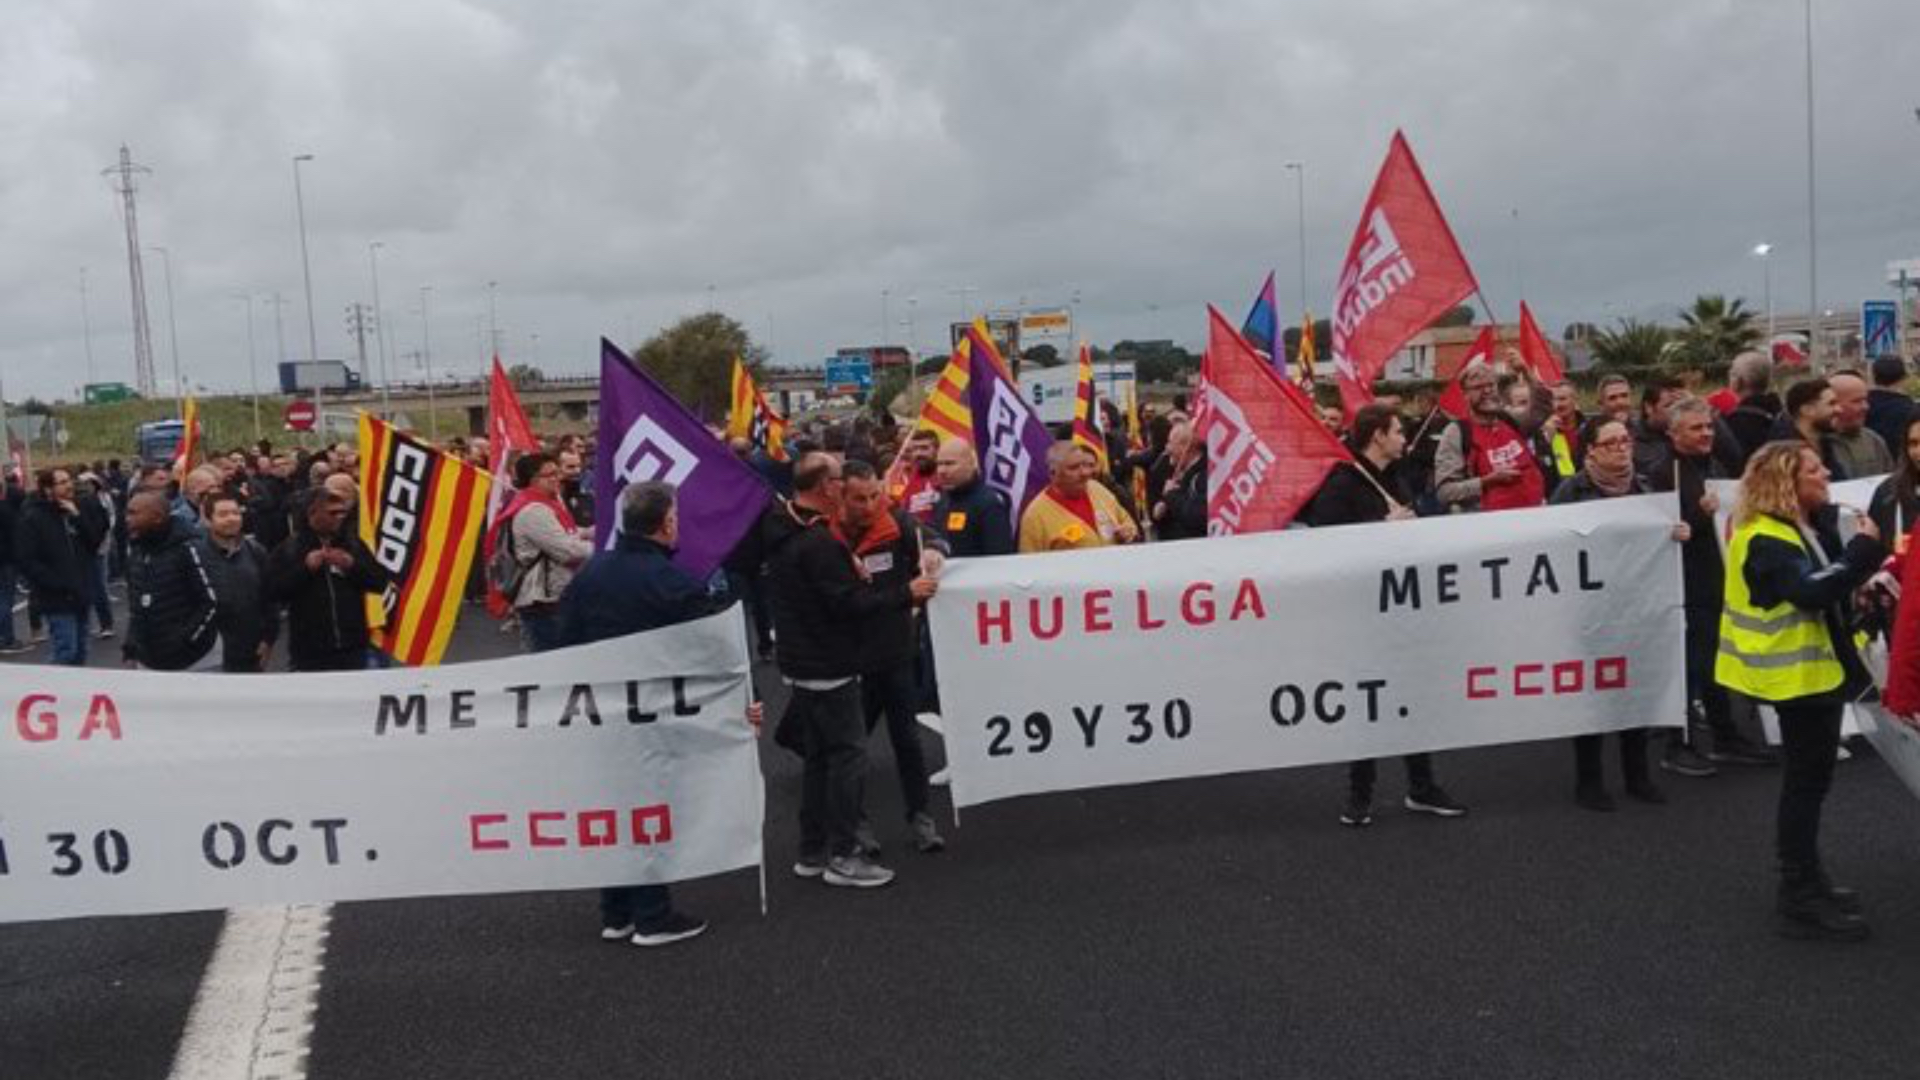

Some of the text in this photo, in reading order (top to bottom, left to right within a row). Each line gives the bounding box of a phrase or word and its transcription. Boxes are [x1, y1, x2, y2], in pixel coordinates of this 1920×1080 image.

[376, 443, 428, 573] CCOO
[975, 549, 1605, 646] HUELGA METAL
[375, 677, 702, 736] METALL
[1467, 656, 1628, 701] CCOO
[985, 679, 1410, 757] 29 Y 30 OCT.
[46, 829, 131, 876] 30
[201, 818, 378, 870] OCT.
[469, 803, 674, 852] CCOO
